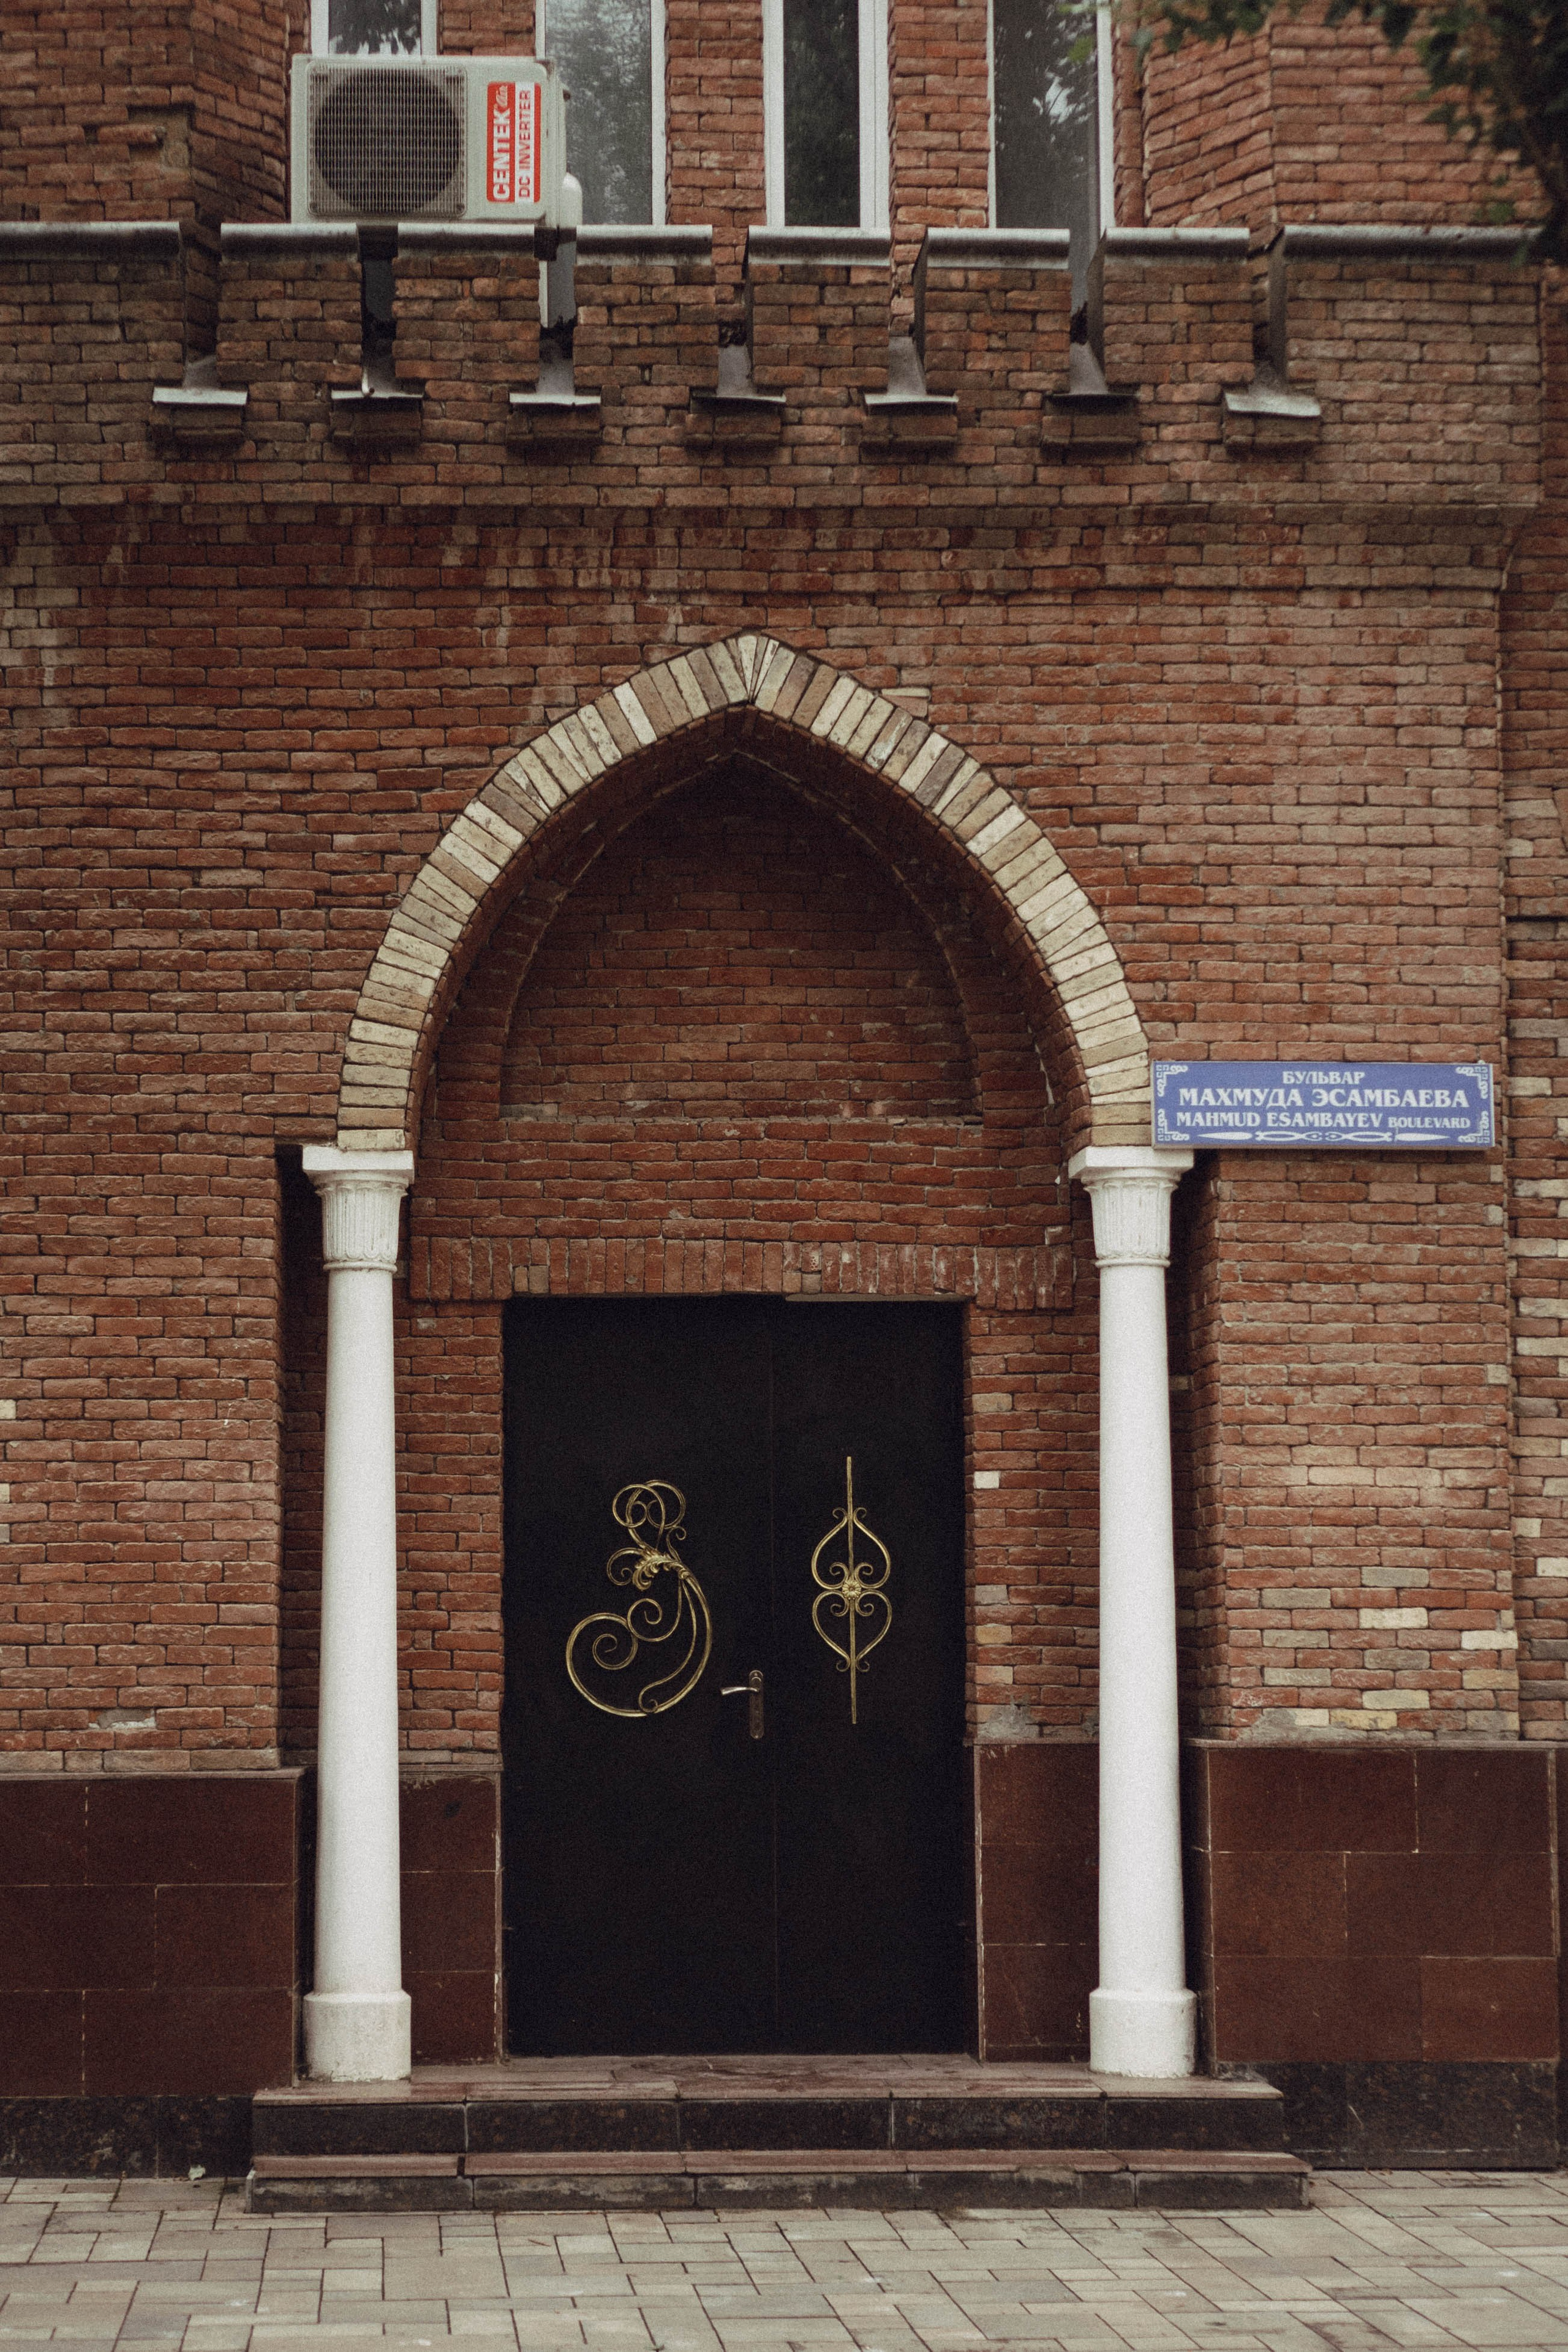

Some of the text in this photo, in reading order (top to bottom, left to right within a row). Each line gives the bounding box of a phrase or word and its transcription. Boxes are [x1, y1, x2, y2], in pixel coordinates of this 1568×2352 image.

[492, 108, 510, 200] CENTEK
[519, 90, 531, 198] DC INVERTER
[1282, 1071, 1366, 1084] БУЛЬВАР
[1178, 1088, 1470, 1109] МАХМУДА ЭСАМБАЕВА
[1176, 1112, 1471, 1129] MAHMUD ESAMBAYEV BOULEVARD
